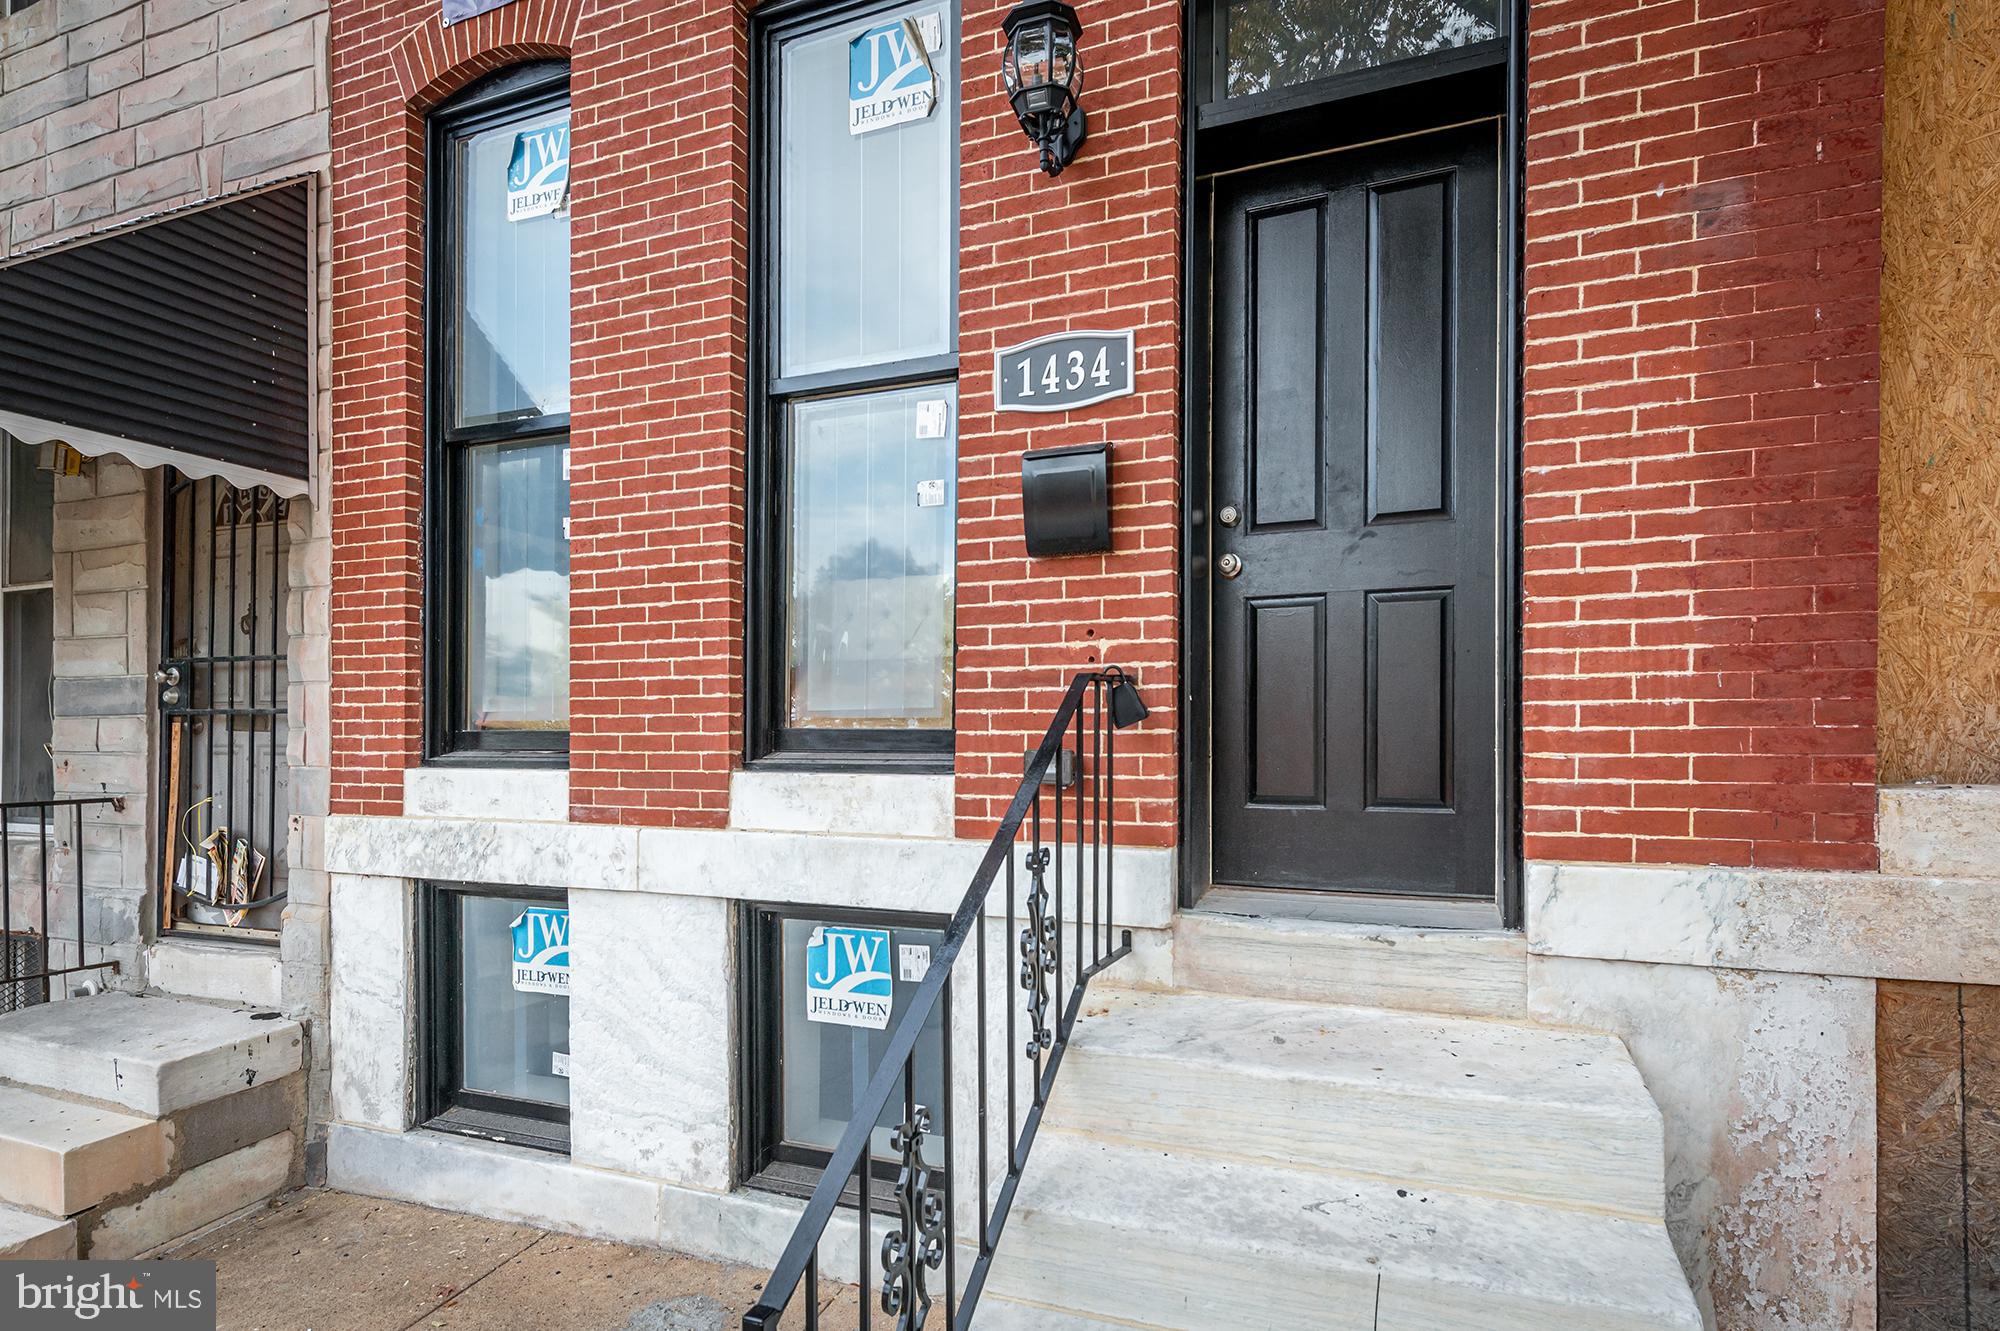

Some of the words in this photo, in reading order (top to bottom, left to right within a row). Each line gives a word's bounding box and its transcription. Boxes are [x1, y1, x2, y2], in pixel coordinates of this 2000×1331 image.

[514, 127, 567, 186] JW
[1018, 346, 1110, 397] 1434
[518, 913, 568, 958] JW
[815, 932, 884, 985] JW
